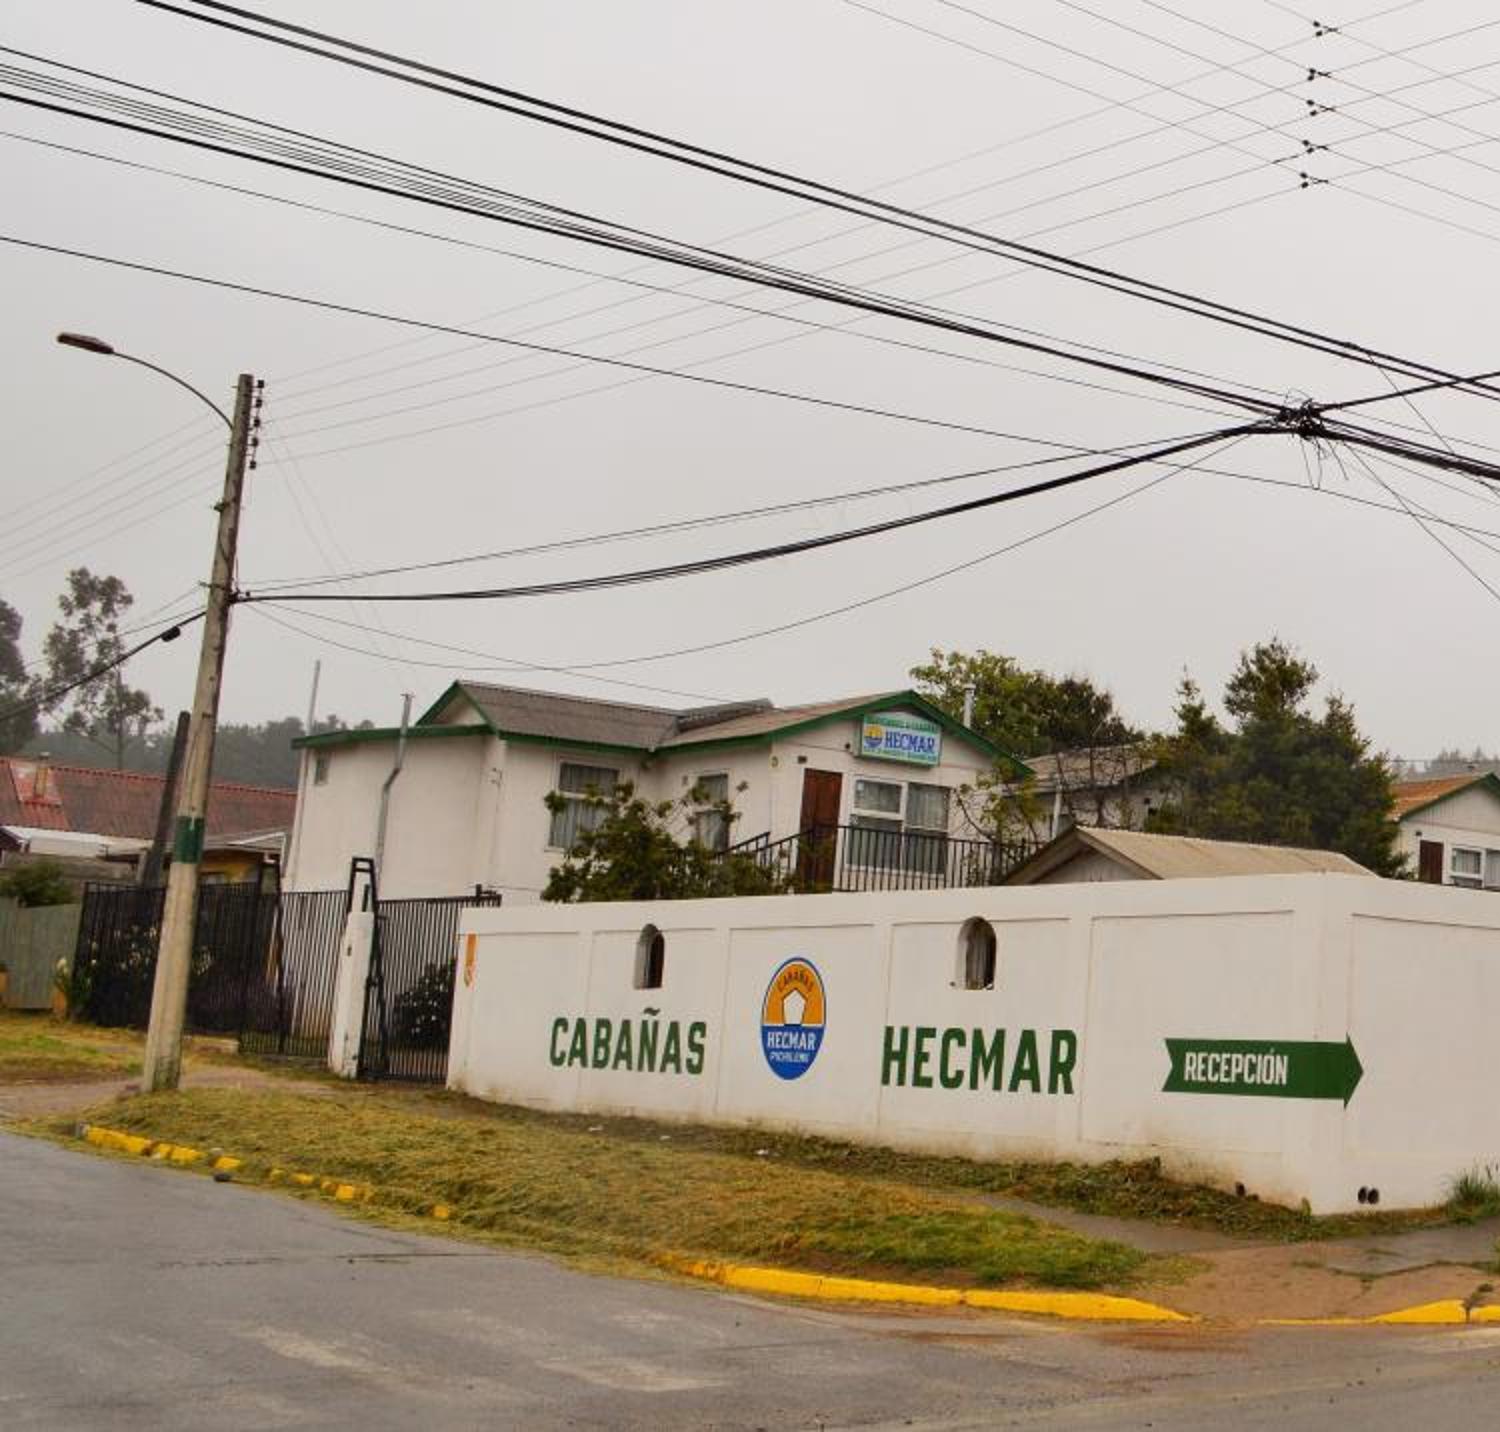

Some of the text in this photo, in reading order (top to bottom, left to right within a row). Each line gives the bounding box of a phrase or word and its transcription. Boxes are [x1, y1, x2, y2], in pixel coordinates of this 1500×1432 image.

[885, 730, 935, 752] HECMAR
[549, 1008, 706, 1075] CABAÑAS
[767, 1031, 816, 1051] HECMAR
[880, 1025, 1078, 1096] HECMAR
[1183, 1047, 1289, 1085] RECEPCIÓN
